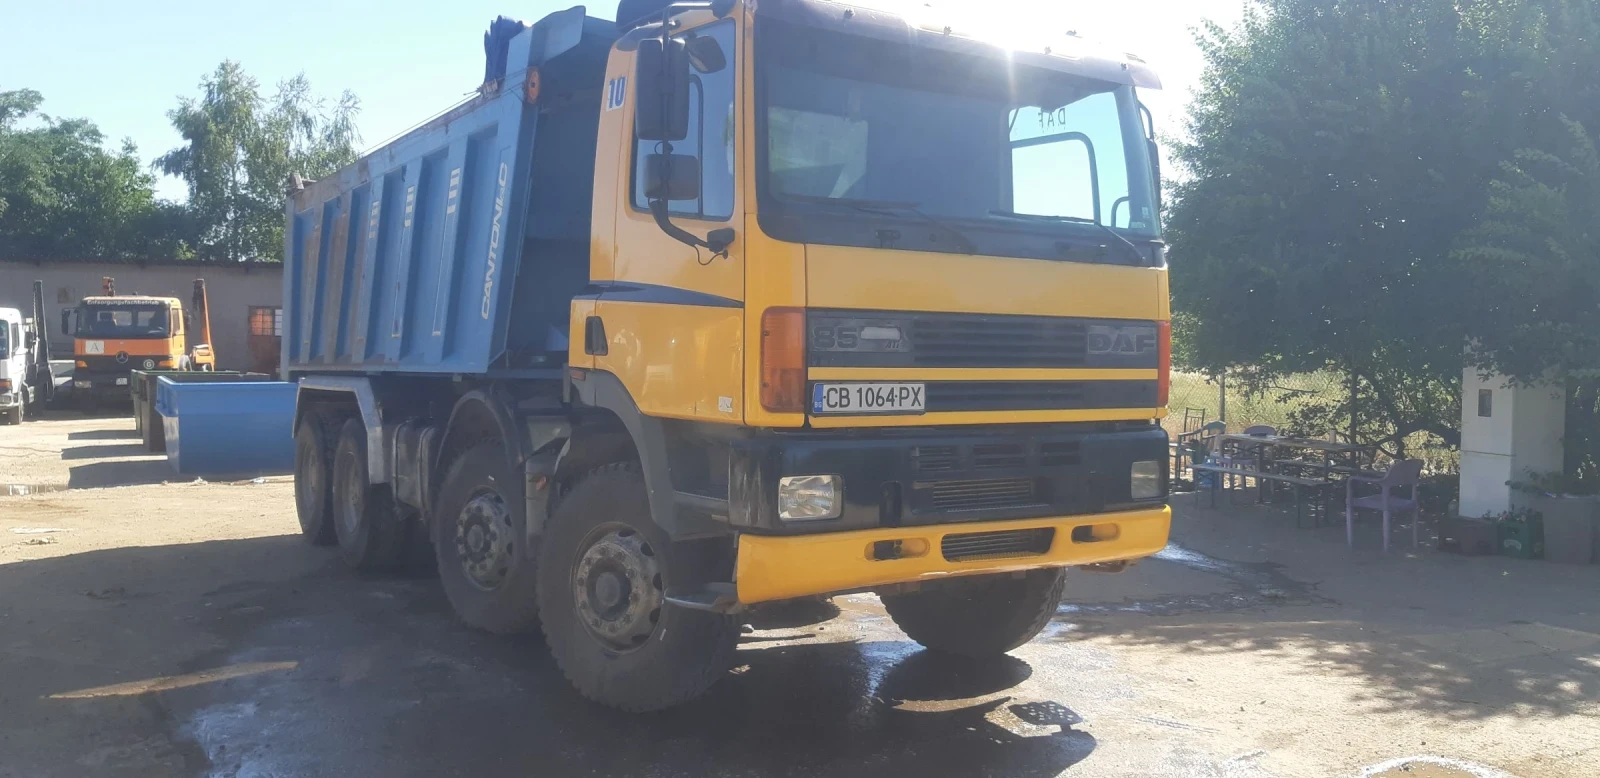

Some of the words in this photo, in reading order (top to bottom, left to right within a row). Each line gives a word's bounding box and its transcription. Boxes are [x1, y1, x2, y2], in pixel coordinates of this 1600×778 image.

[609, 76, 626, 108] 10
[90, 343, 99, 353] A
[813, 326, 859, 349] 85
[1088, 333, 1156, 352] DAF
[826, 387, 850, 408] CB
[857, 387, 895, 407] 1064
[899, 387, 921, 407] PX
